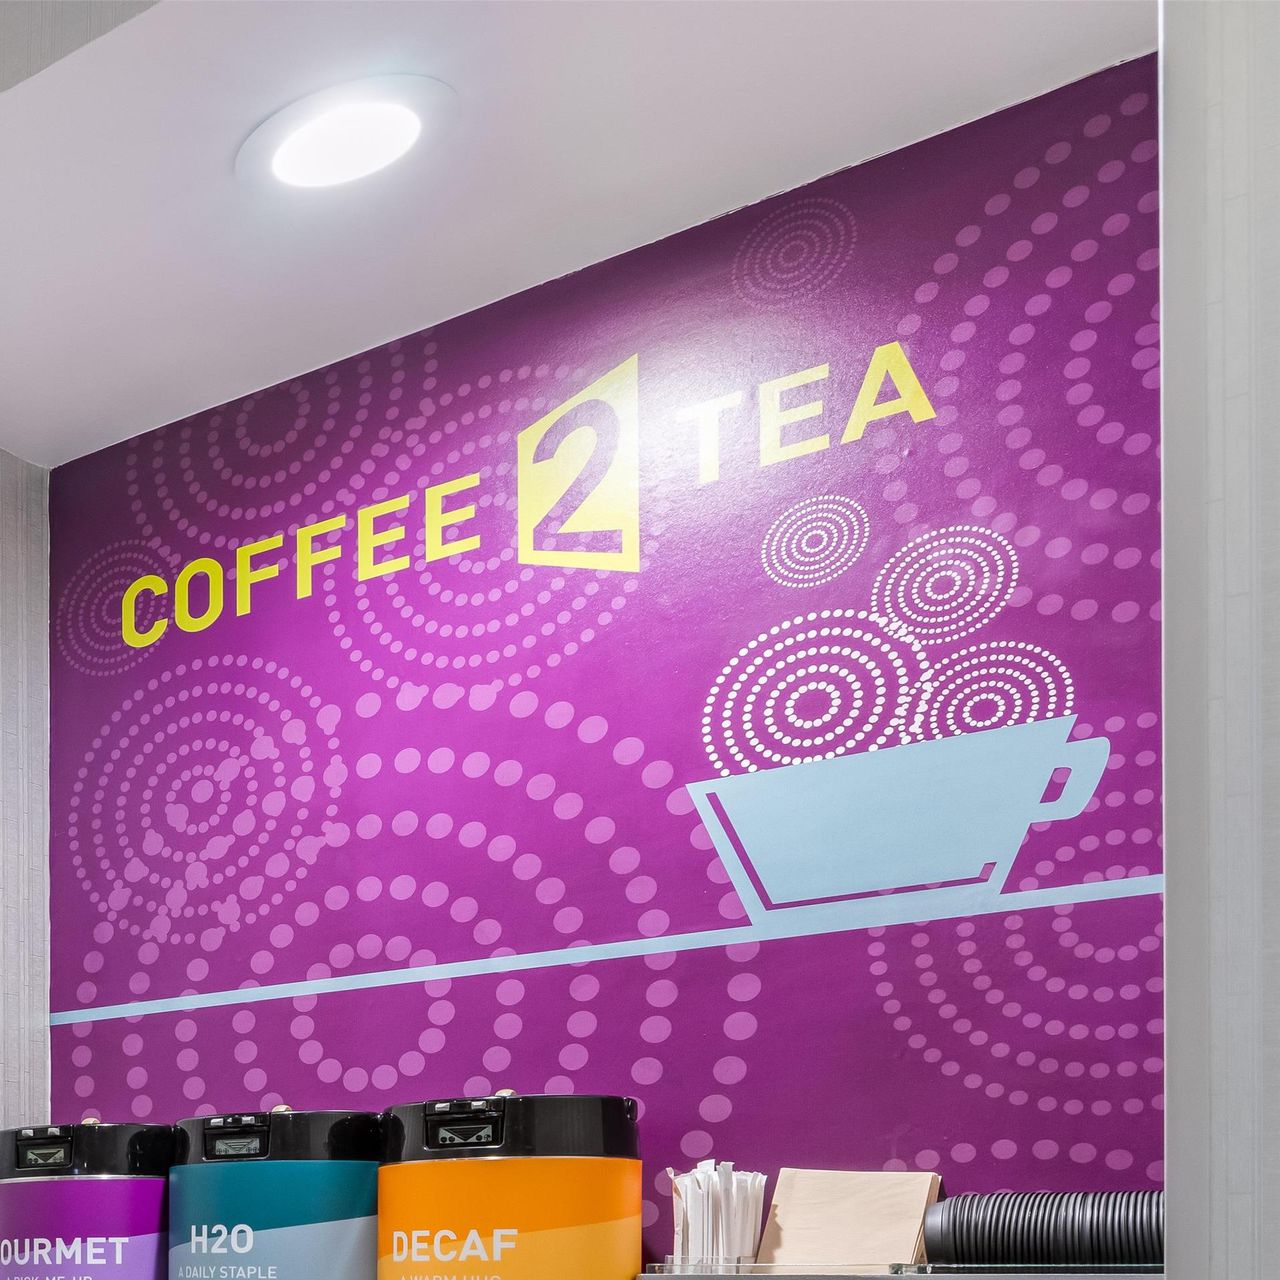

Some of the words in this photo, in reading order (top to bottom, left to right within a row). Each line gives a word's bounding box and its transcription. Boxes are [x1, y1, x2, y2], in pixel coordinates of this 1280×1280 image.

[120, 472, 482, 650] COFFEE
[531, 394, 627, 556] 2
[685, 340, 938, 487] TEA
[191, 1224, 254, 1254] H2O
[393, 1229, 519, 1262] DECAF
[178, 1266, 184, 1279] A
[185, 1266, 217, 1279] DAILY
[219, 1266, 278, 1280] STAPLE
